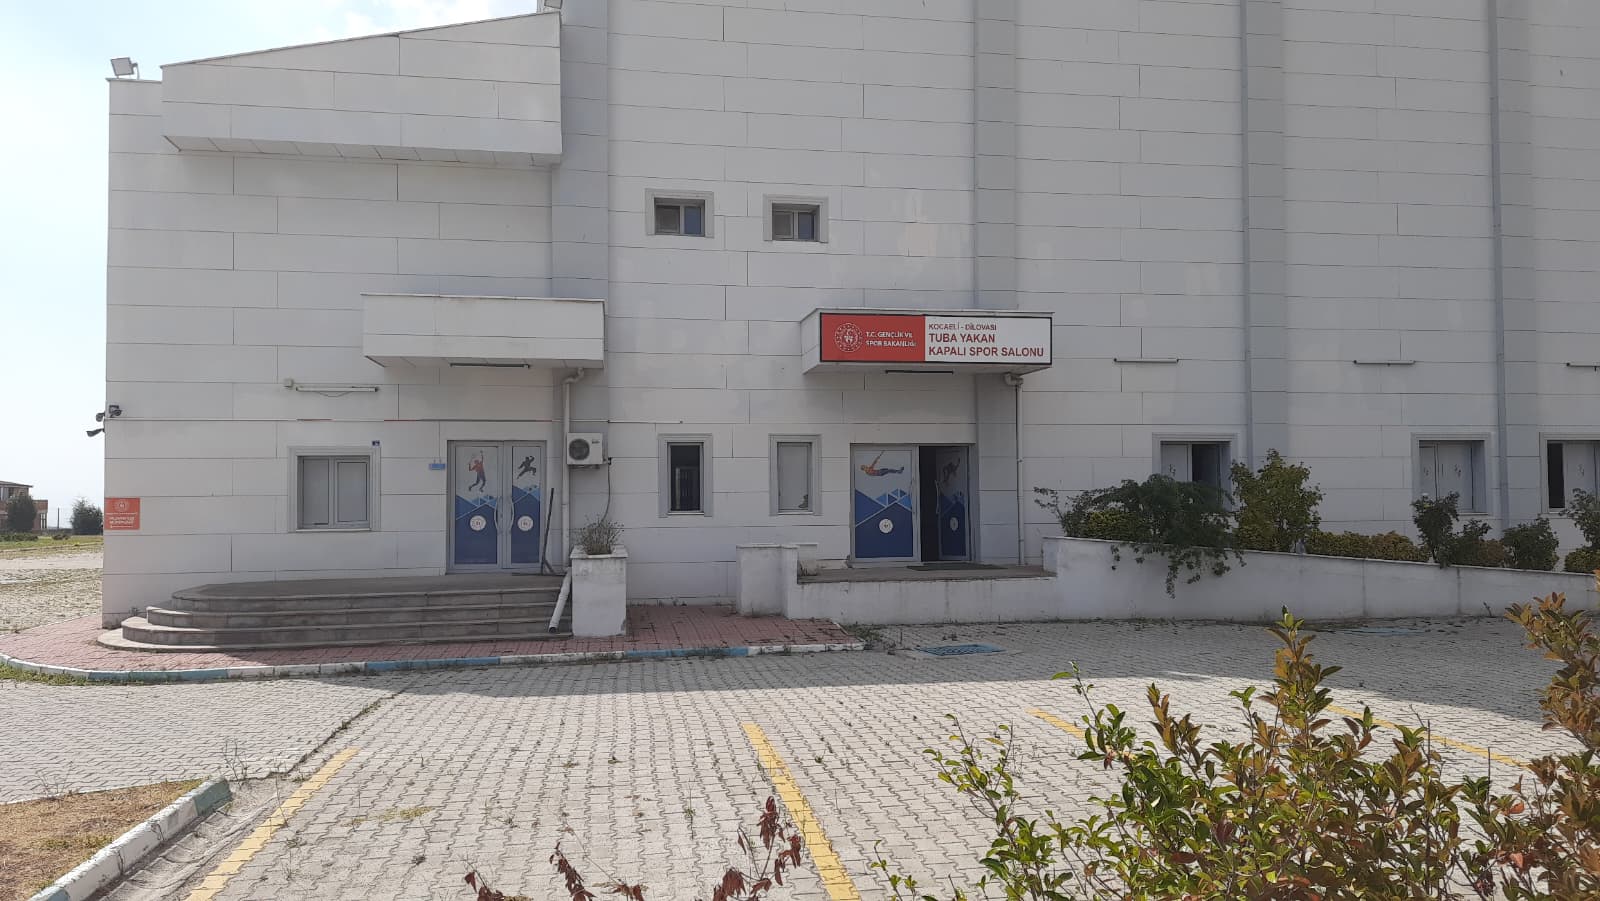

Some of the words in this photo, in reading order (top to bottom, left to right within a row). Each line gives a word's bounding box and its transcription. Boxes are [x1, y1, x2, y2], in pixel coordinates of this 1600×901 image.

[928, 322, 960, 331] KOCAELİ
[965, 322, 997, 331] DİLOVASI
[877, 330, 903, 339] GENÇLİK
[928, 333, 957, 343] TUBA
[960, 333, 995, 343] YAKAN
[928, 346, 966, 356] KAPALI
[969, 346, 999, 356] SPOR
[1001, 347, 1044, 357] SALONU
